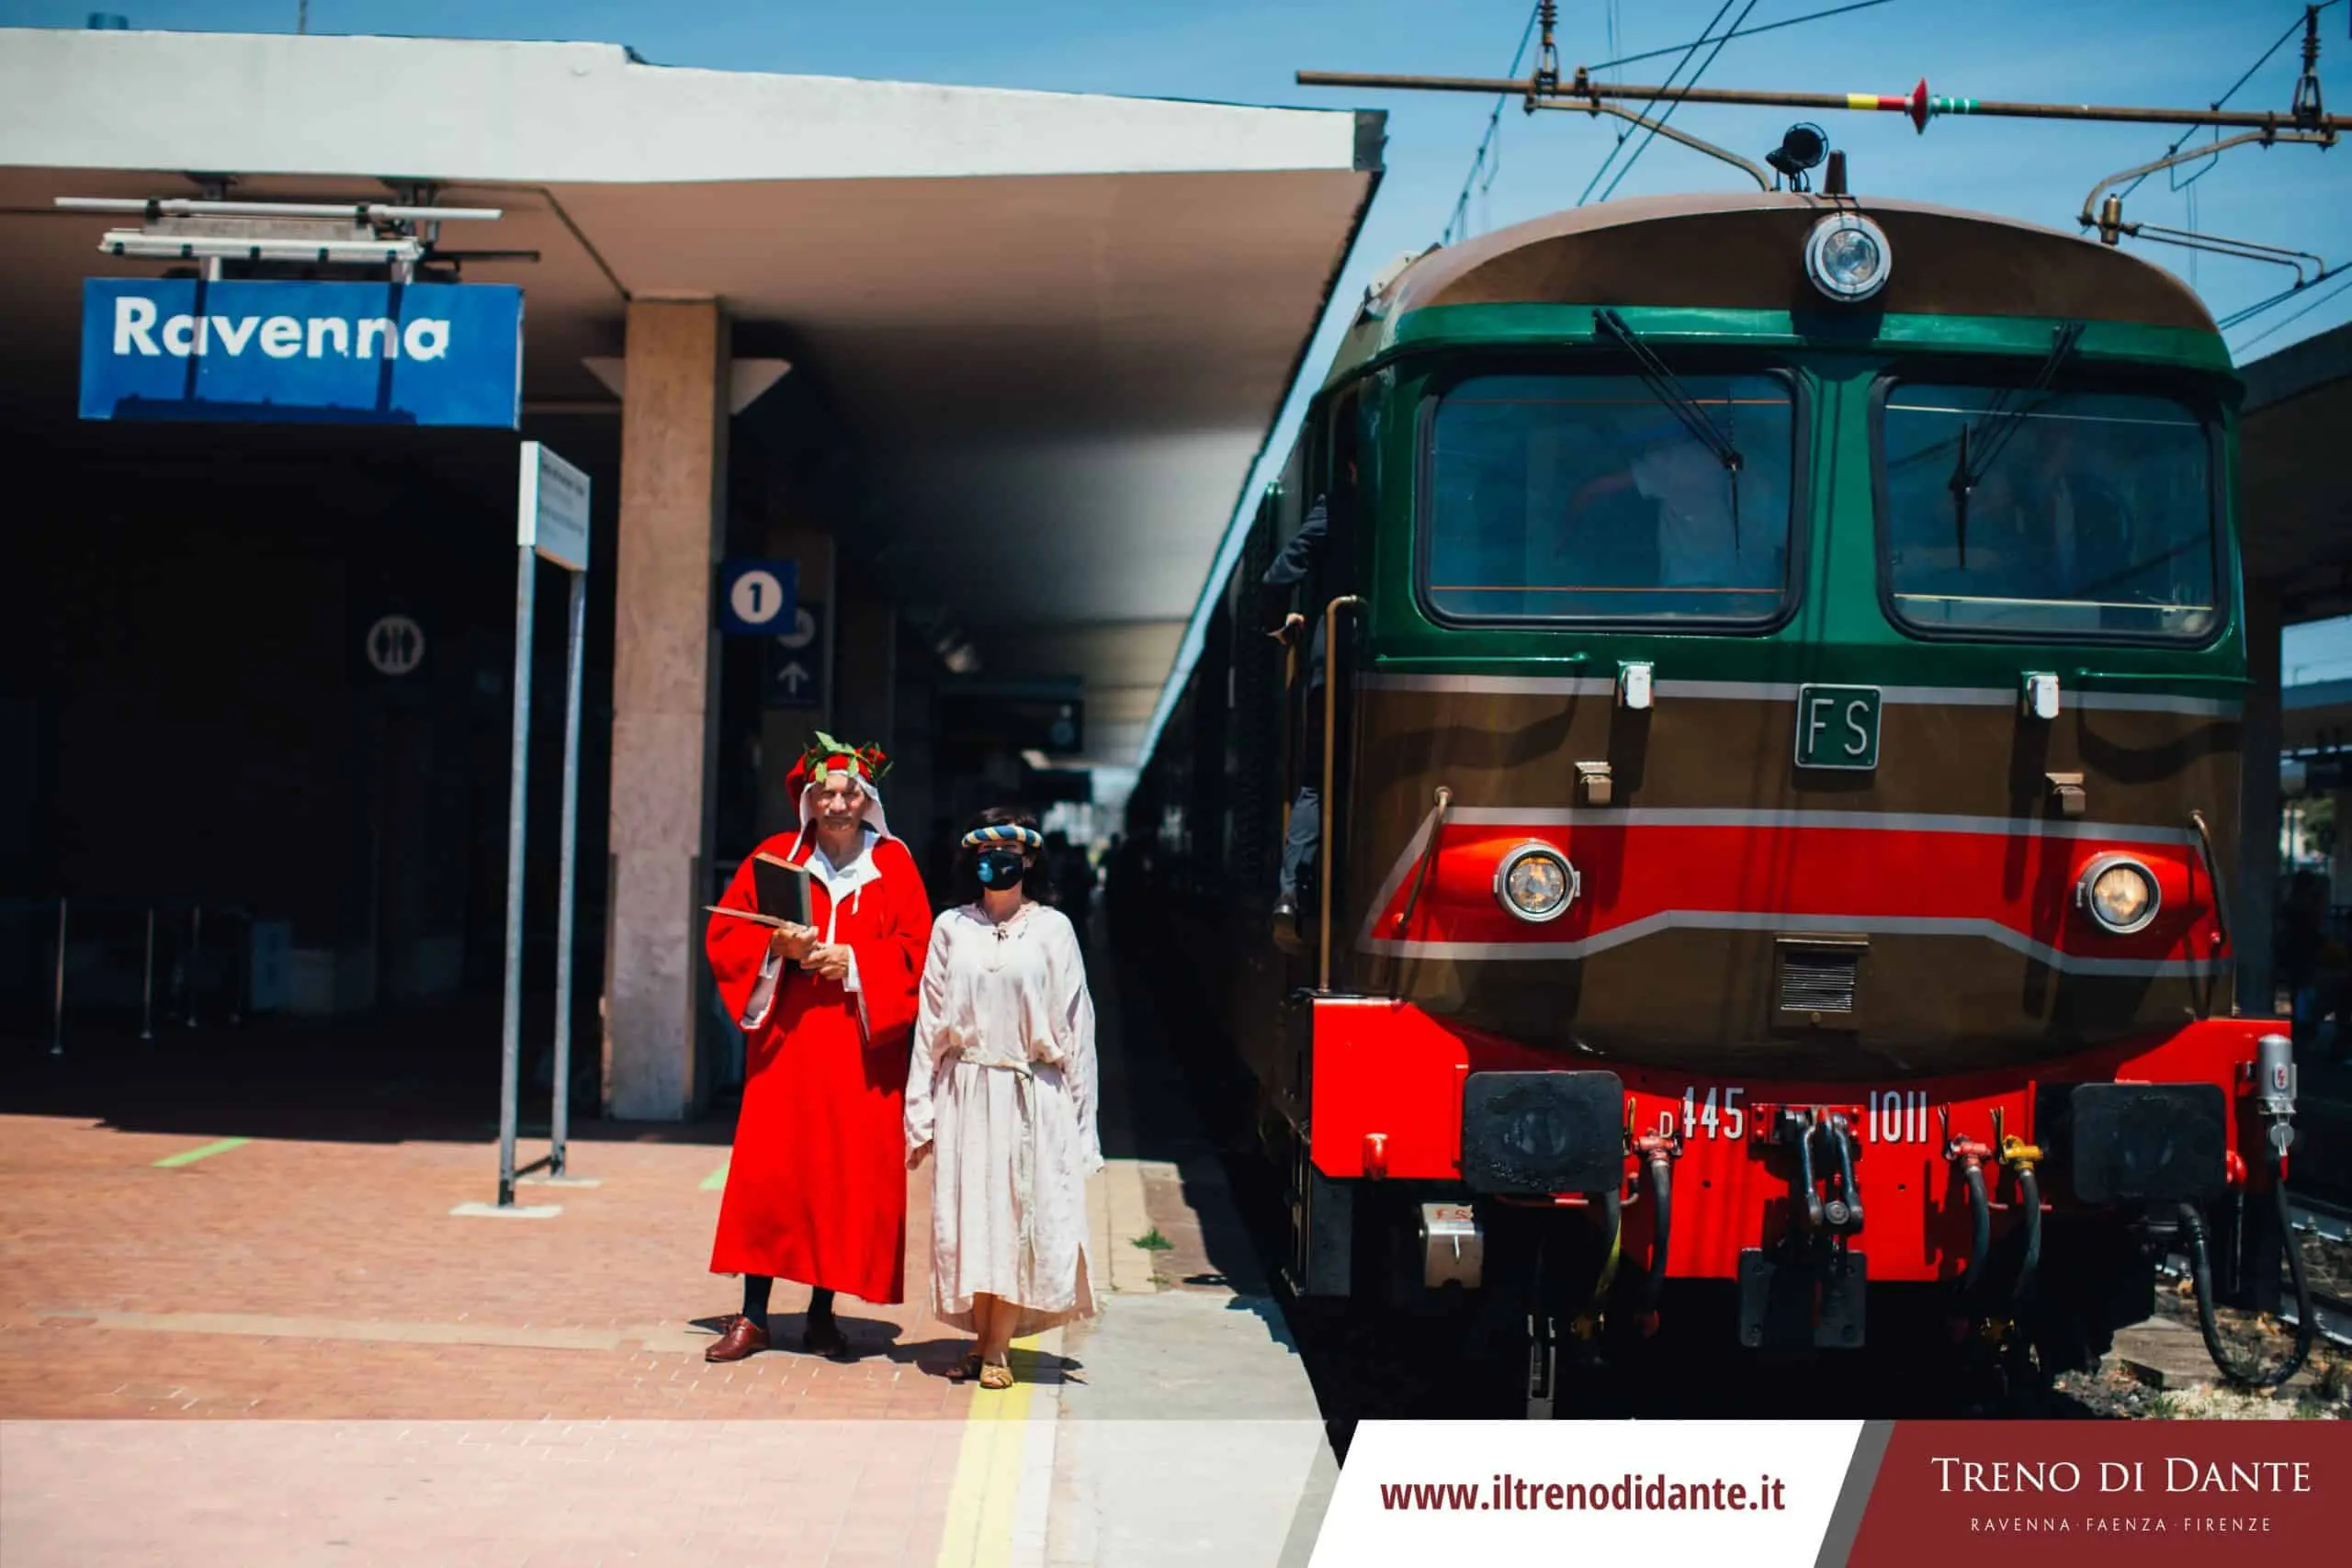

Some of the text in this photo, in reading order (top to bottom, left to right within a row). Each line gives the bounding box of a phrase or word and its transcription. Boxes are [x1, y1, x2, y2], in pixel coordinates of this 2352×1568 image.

[113, 296, 451, 362] Ravenna
[749, 581, 763, 614] 1
[1807, 698, 1871, 754] FS
[1683, 1087, 1745, 1139] 445
[1869, 1090, 1928, 1144] 1011
